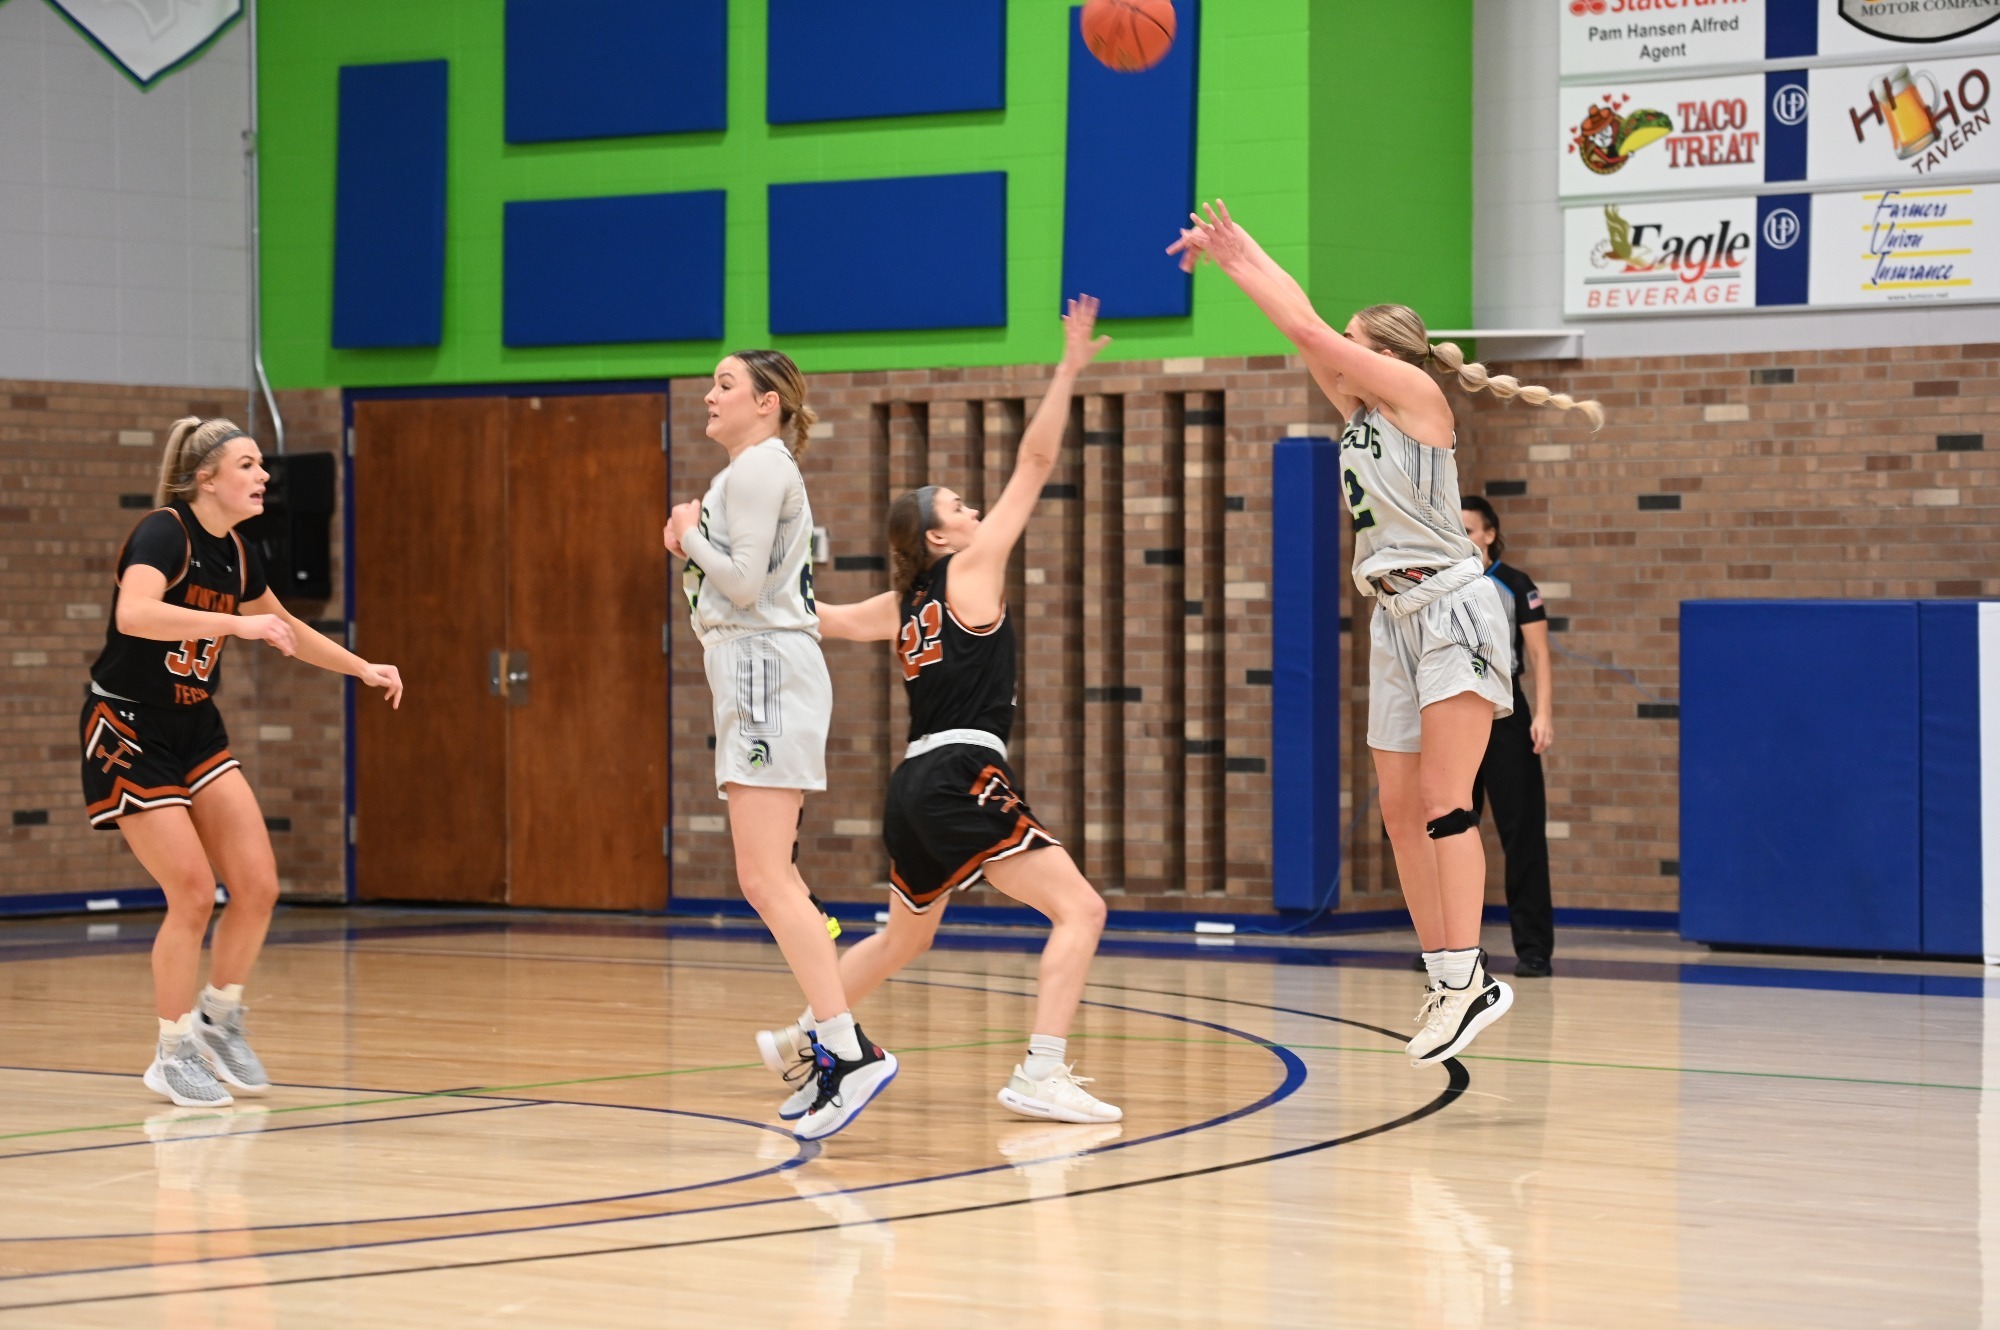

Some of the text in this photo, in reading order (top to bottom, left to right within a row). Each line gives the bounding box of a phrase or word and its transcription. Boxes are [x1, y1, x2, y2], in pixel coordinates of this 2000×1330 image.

[1861, 2, 1919, 16] MOTOR
[1589, 16, 1739, 41] Pam Hansen Alfred
[1639, 43, 1686, 62] Agent
[1677, 98, 1748, 133] TACO
[1665, 132, 1759, 168] TREAT
[1911, 107, 1991, 174] TAVERN
[1873, 190, 1948, 222] Farmers
[1620, 220, 1750, 284] Eagle
[1870, 221, 1924, 255] Union
[1871, 250, 1954, 286] Insurance
[1587, 284, 1741, 308] BEVERAGE
[897, 599, 943, 681] 22
